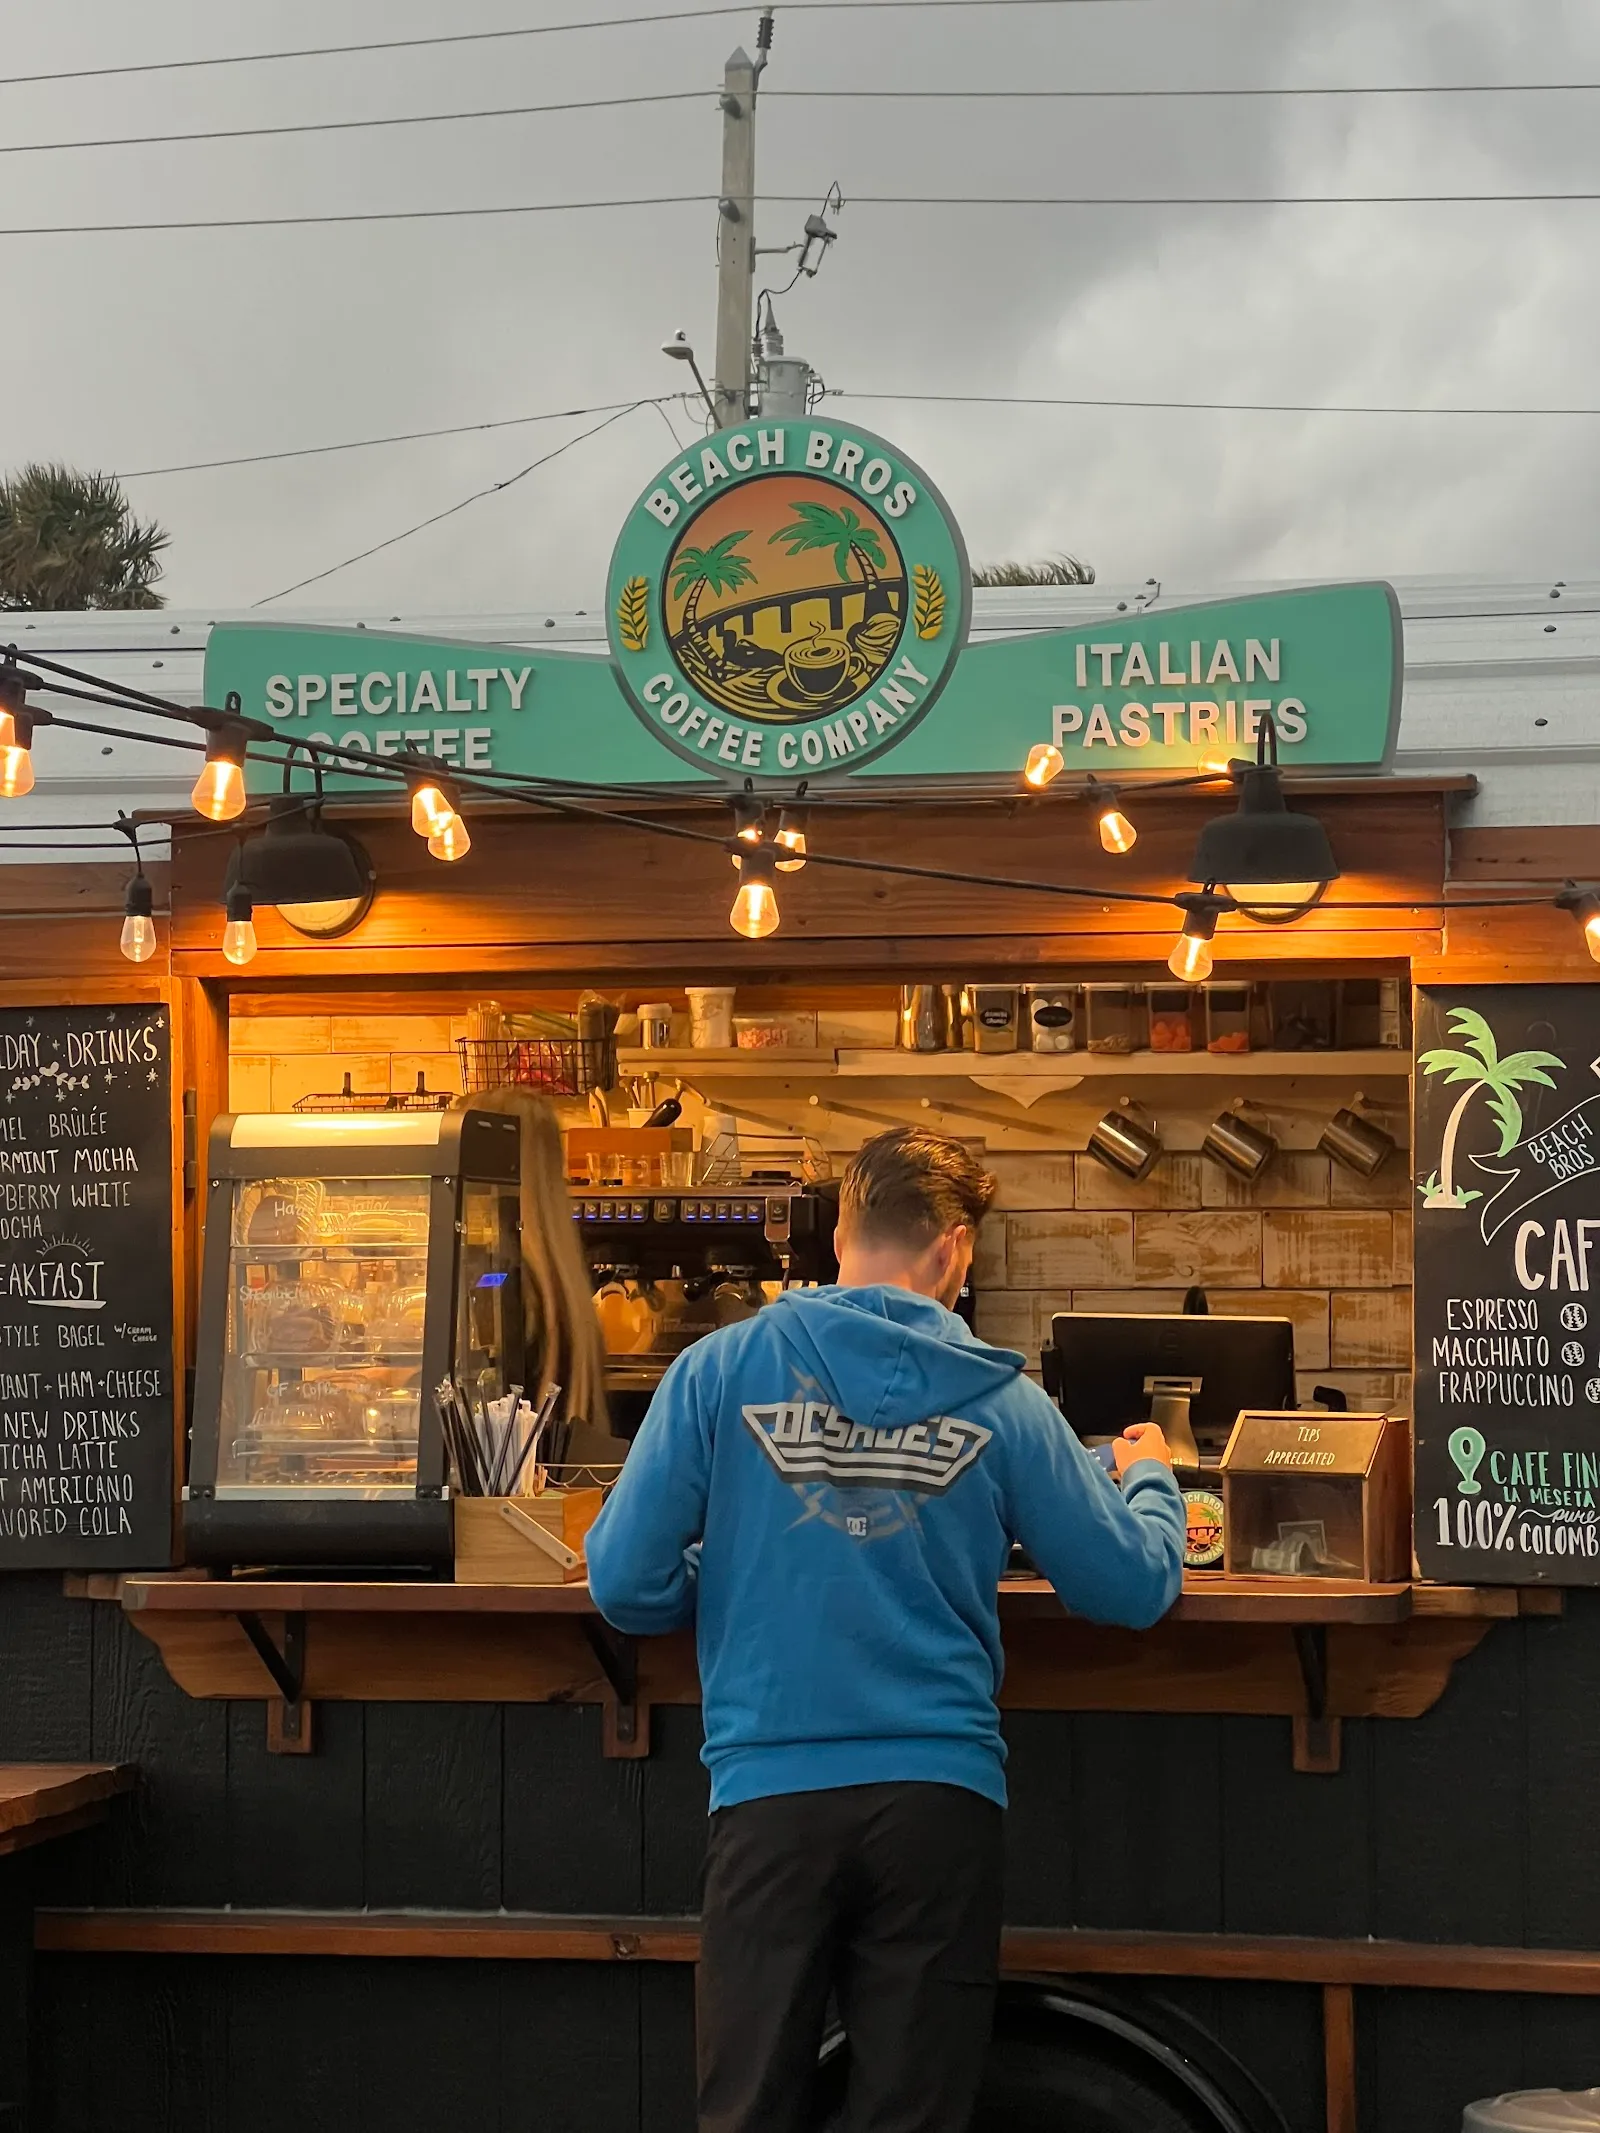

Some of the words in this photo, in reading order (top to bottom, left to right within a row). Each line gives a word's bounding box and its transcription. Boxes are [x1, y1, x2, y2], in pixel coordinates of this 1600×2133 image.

[643, 429, 785, 527] BEACH
[805, 430, 916, 517] BROS
[1076, 638, 1280, 687] ITALIAN
[265, 667, 533, 718] SPECIALTY
[642, 673, 765, 767] COFFEE
[777, 656, 929, 768] COMPANY
[1052, 698, 1308, 748] PASTRIES
[67, 1026, 158, 1068] DRINKS
[49, 1105, 108, 1139] BRÛLÉE
[1527, 1112, 1594, 1164] BEACH
[0, 1149, 59, 1174] RMINT
[74, 1147, 139, 1174] MOCHA
[1548, 1143, 1595, 1180] BROS
[71, 1181, 132, 1208] WHITE
[0, 1214, 43, 1240] OCHA
[1514, 1219, 1600, 1292] CAF
[1446, 1298, 1539, 1331] ESPRESSO
[0, 1324, 40, 1348] TYLE
[58, 1324, 105, 1349] BAGEL
[1432, 1335, 1550, 1367] MACCHIATO
[1, 1373, 42, 1400] IANT
[57, 1370, 95, 1400] HAM
[106, 1369, 162, 1398] CHEESE
[1439, 1370, 1574, 1407] FRAPPUCCINO
[4, 1411, 49, 1439] NEW
[63, 1410, 141, 1441] DRINKS
[0, 1443, 48, 1471] TCHA
[58, 1440, 119, 1471] LATTE
[1263, 1449, 1336, 1466] APPRECIATED
[1490, 1450, 1550, 1487] CAFE
[1562, 1451, 1600, 1489] FIN
[20, 1473, 133, 1504] AMERICANO
[1503, 1486, 1521, 1503] LA
[1530, 1487, 1596, 1508] MESETA
[0, 1506, 67, 1538] VORED
[79, 1505, 133, 1536] COLA
[1433, 1497, 1518, 1551] 100%
[1519, 1522, 1600, 1557] COLOMB
